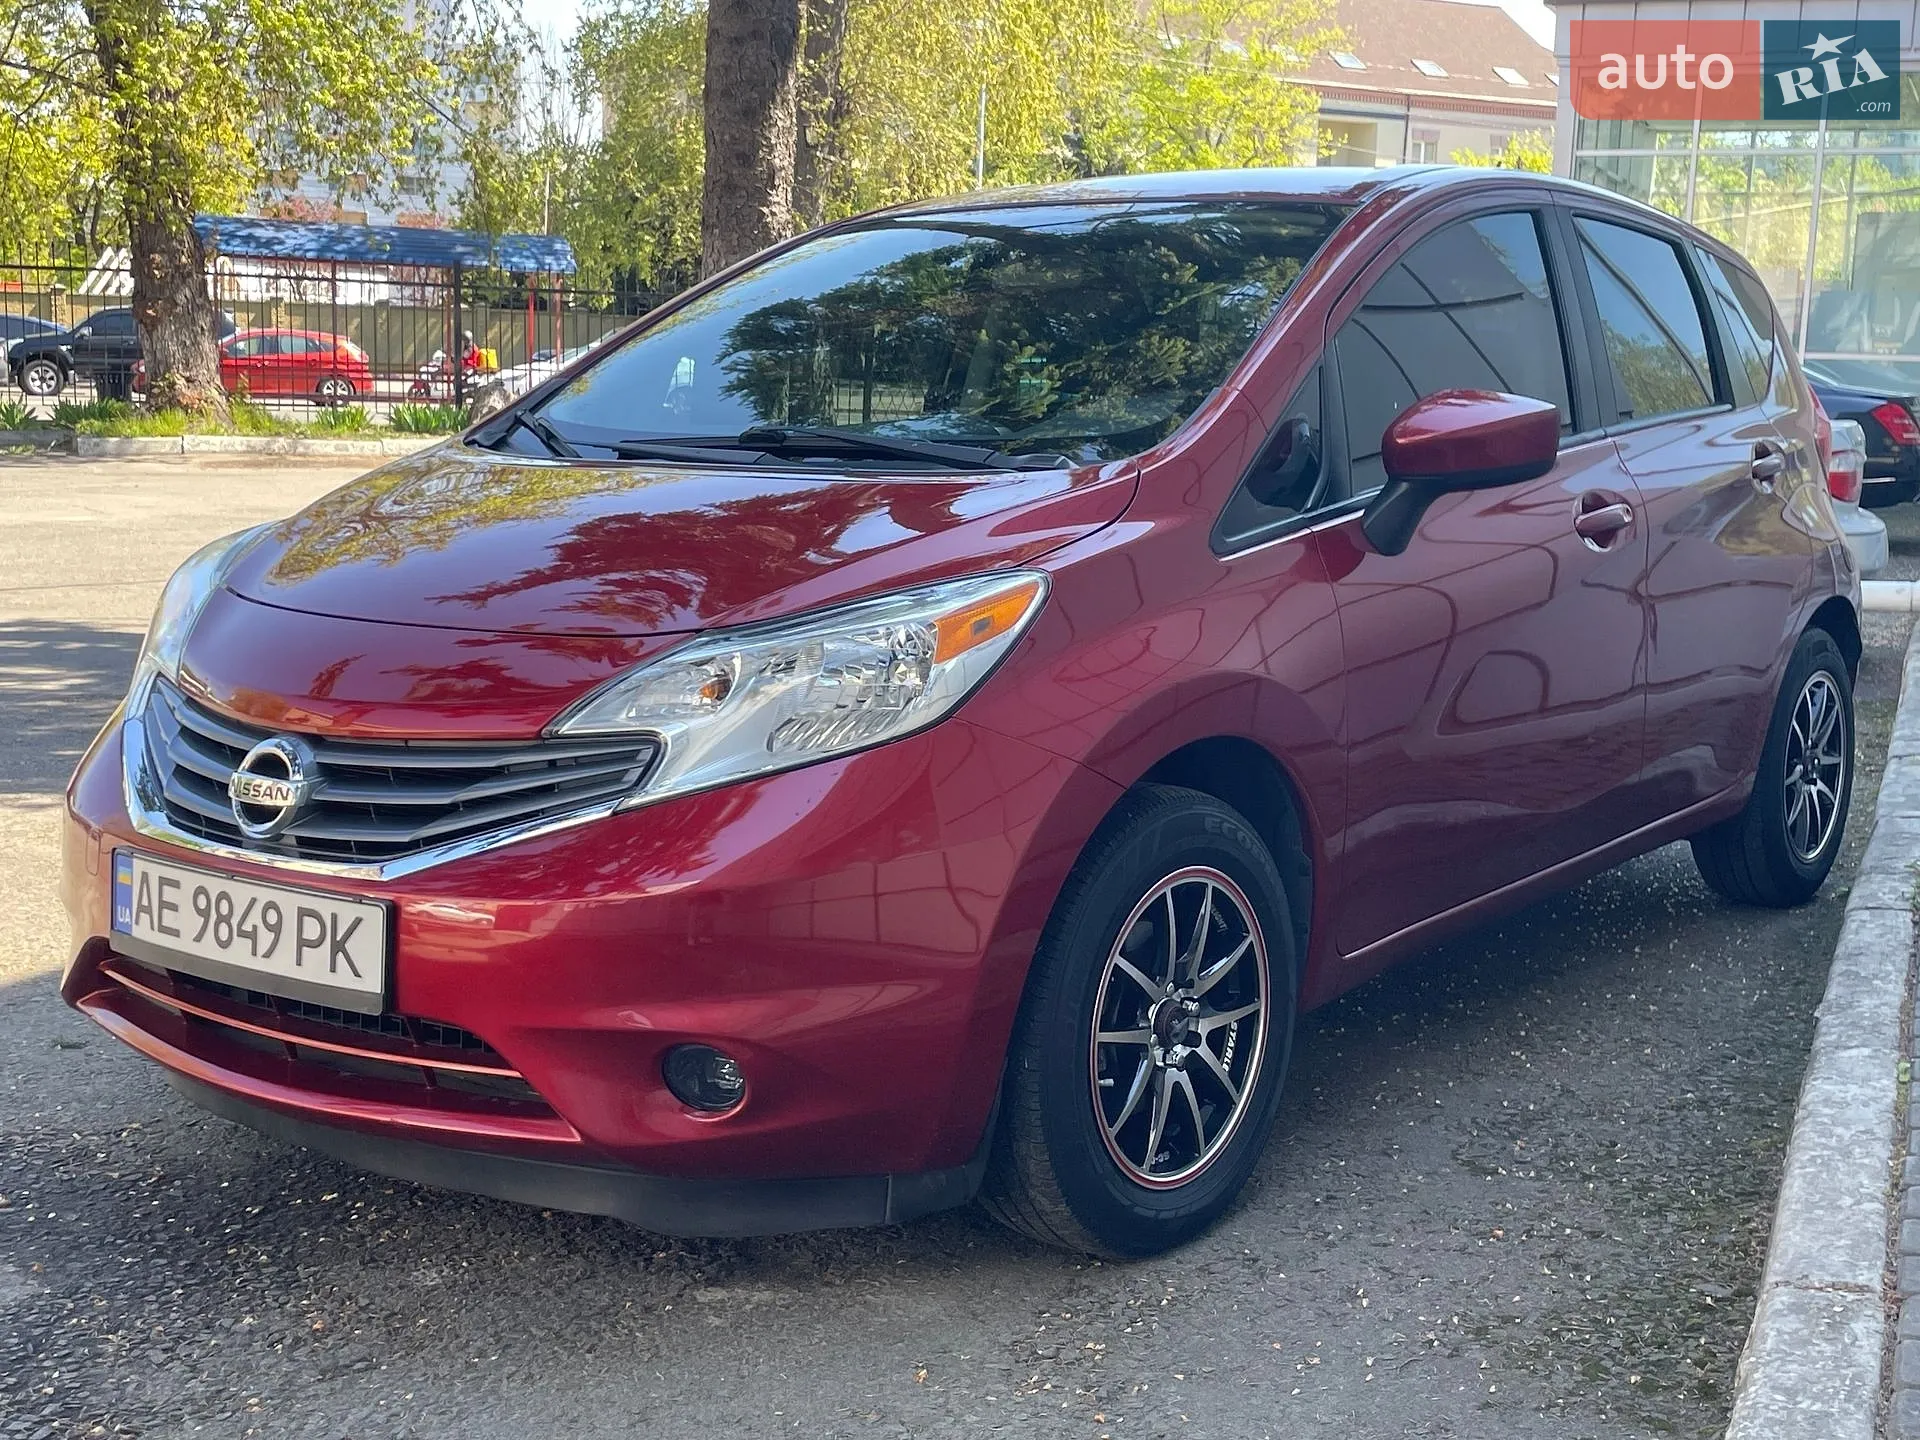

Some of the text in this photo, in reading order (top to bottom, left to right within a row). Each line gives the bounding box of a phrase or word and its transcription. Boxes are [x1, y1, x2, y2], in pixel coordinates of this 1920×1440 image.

[231, 774, 290, 801] NISSAN
[117, 904, 132, 925] UA
[134, 871, 364, 978] AE 9849 PK
